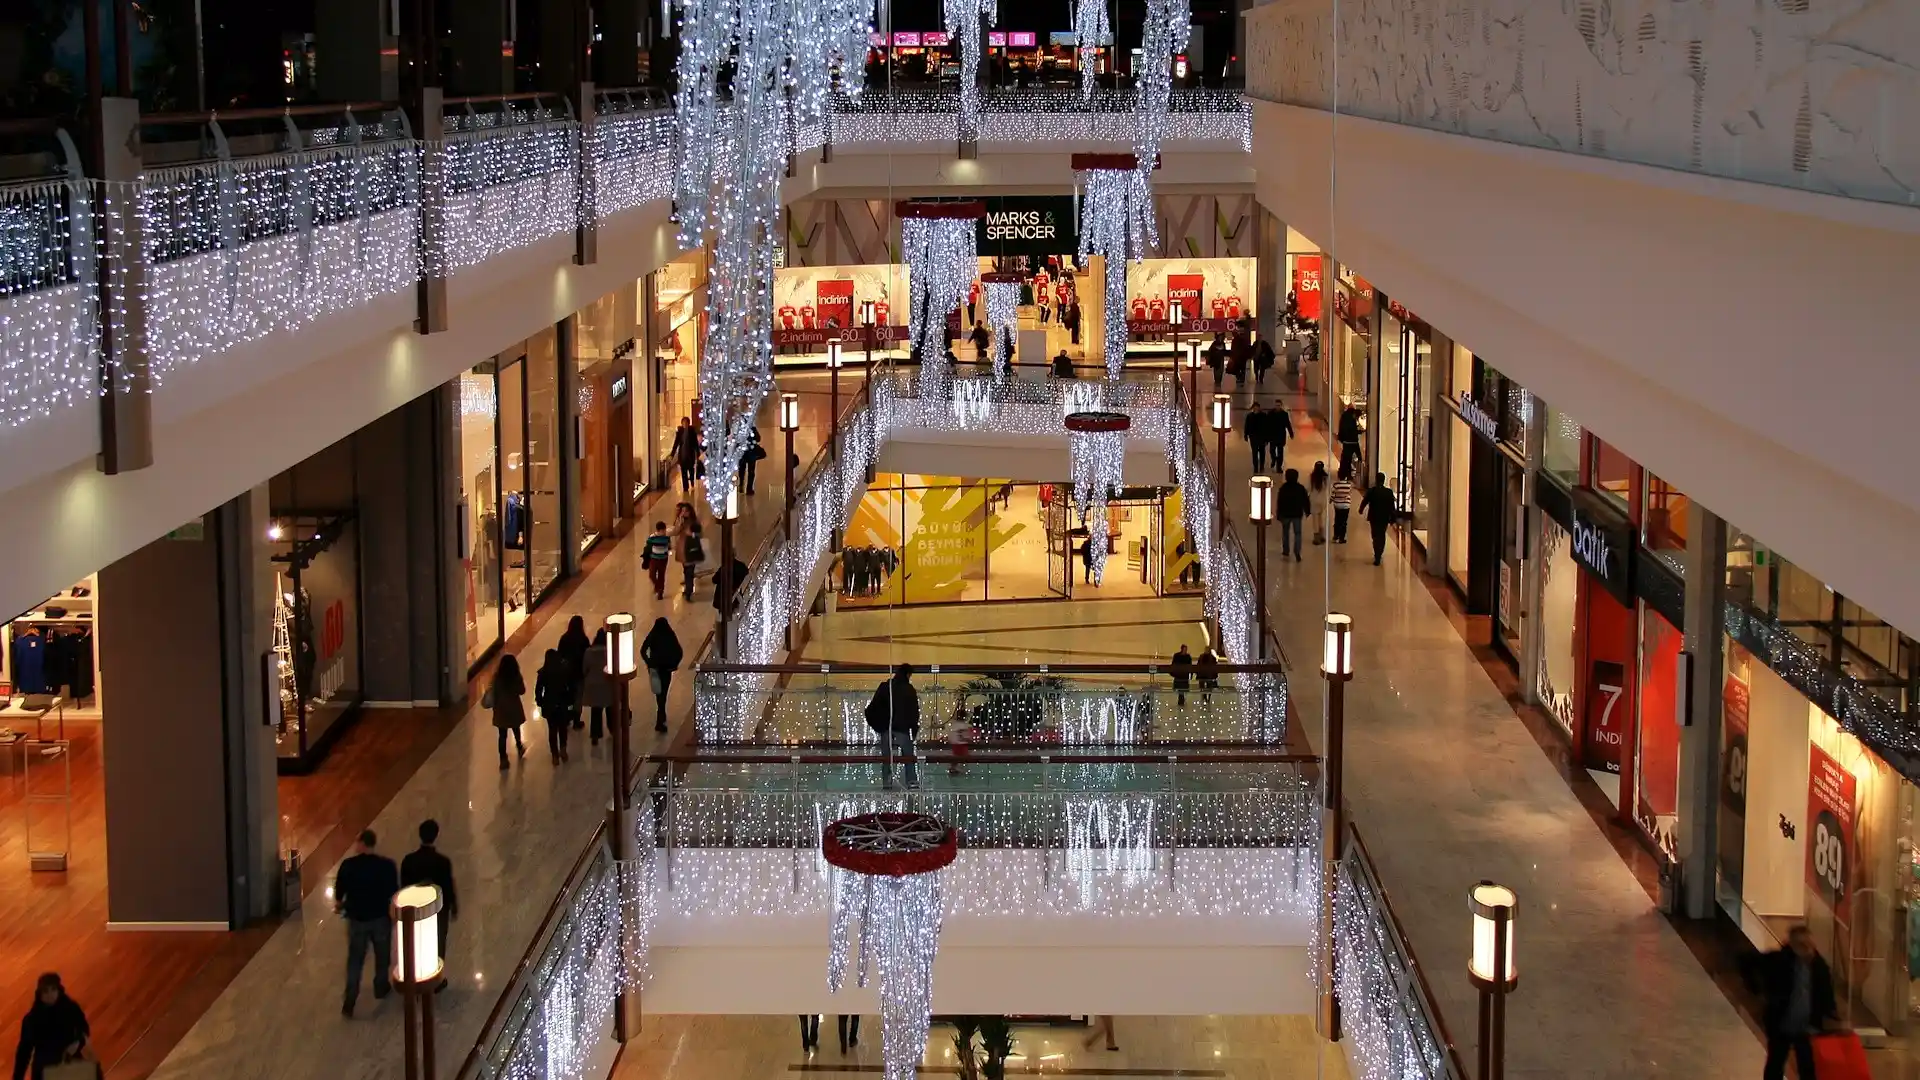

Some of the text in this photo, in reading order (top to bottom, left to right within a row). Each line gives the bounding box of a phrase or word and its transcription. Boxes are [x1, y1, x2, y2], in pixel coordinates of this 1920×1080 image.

[986, 211, 1055, 225] MARKS &
[986, 225, 1055, 240] SPENCER
[1302, 270, 1319, 279] THE
[917, 538, 975, 550] BEYMEN
[1573, 509, 1609, 580] batik
